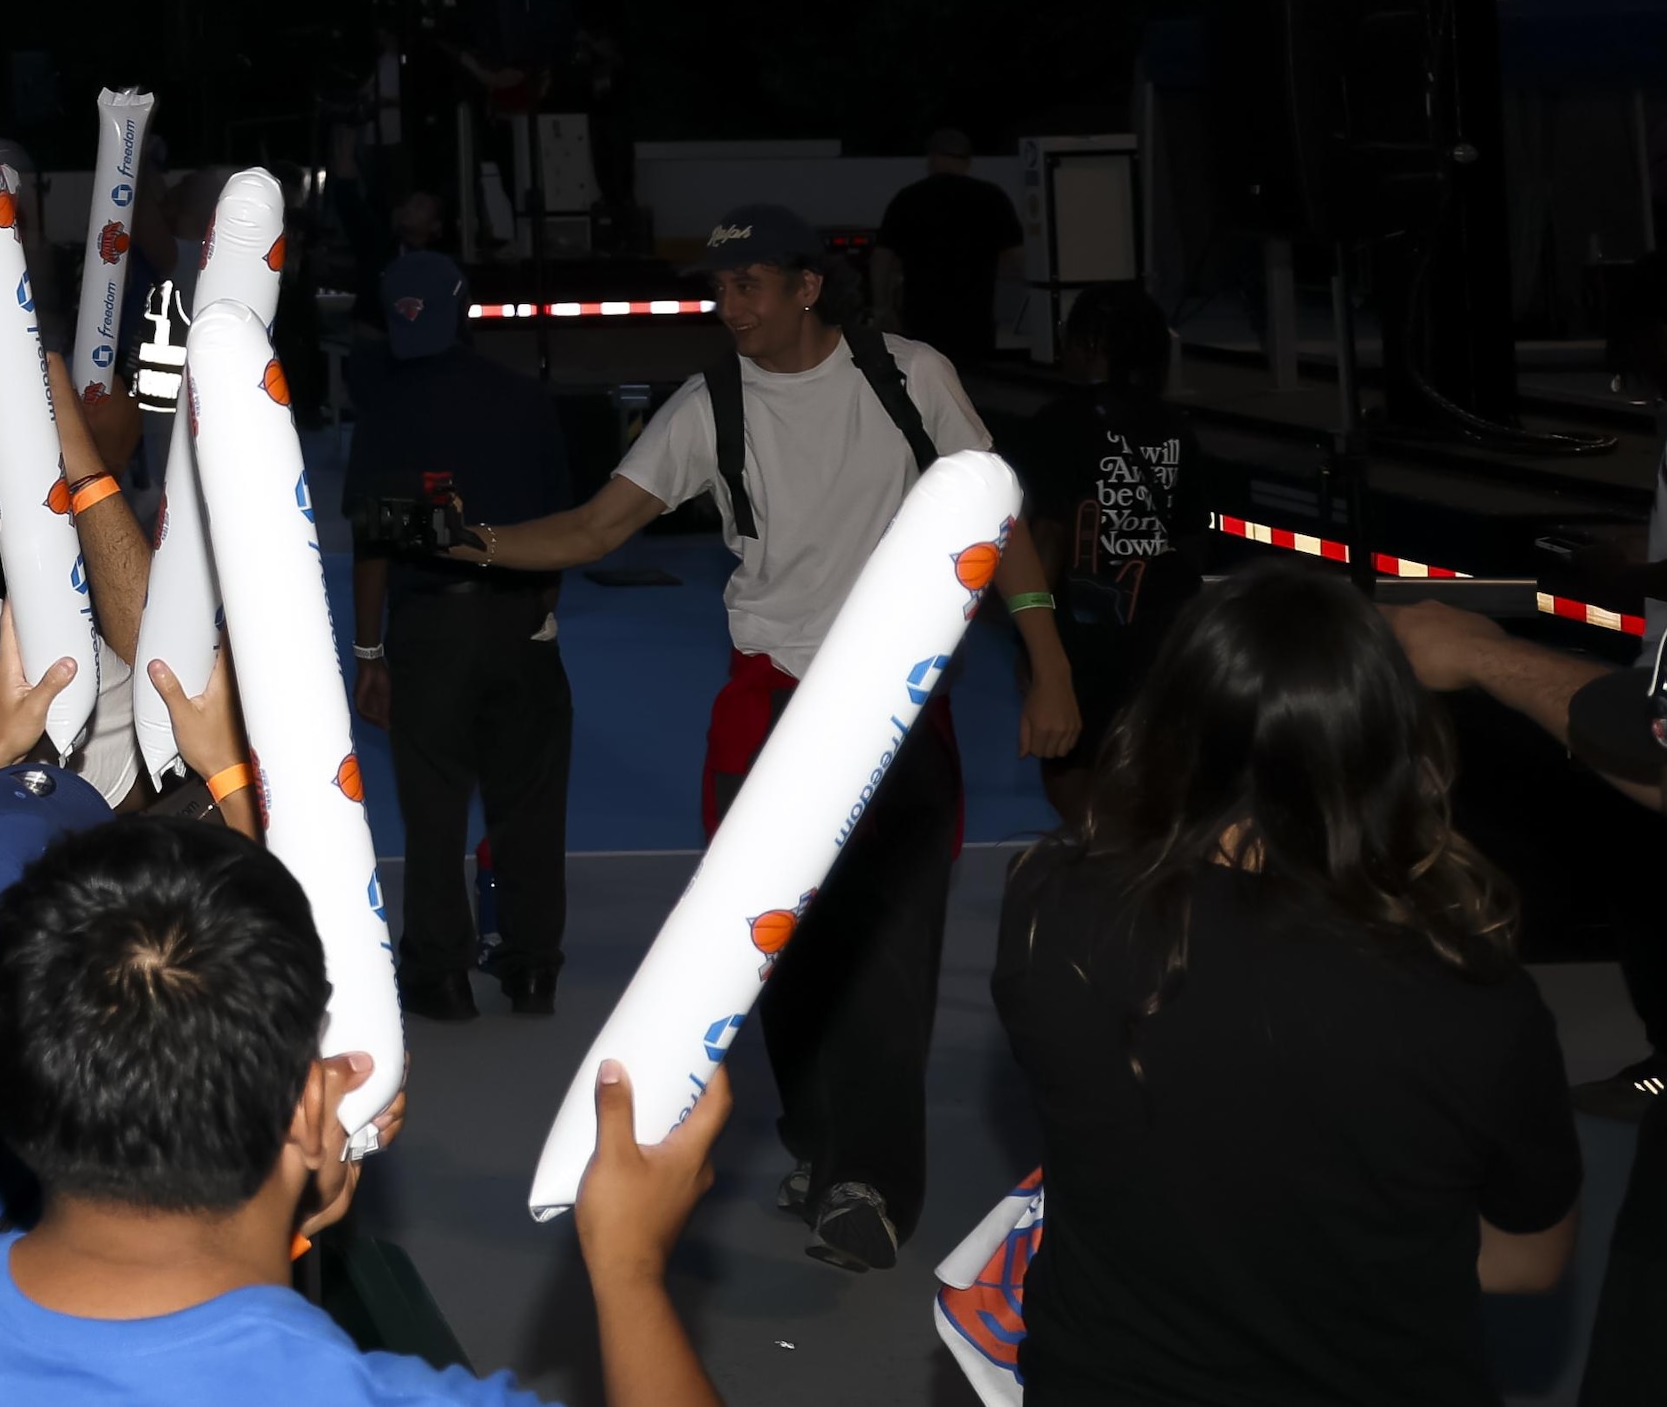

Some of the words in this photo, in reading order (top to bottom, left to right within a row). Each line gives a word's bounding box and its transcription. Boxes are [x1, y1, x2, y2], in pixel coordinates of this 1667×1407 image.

[117, 119, 135, 179] freedom
[97, 281, 116, 340] freedom
[1139, 438, 1180, 465] will
[1095, 479, 1134, 507] be
